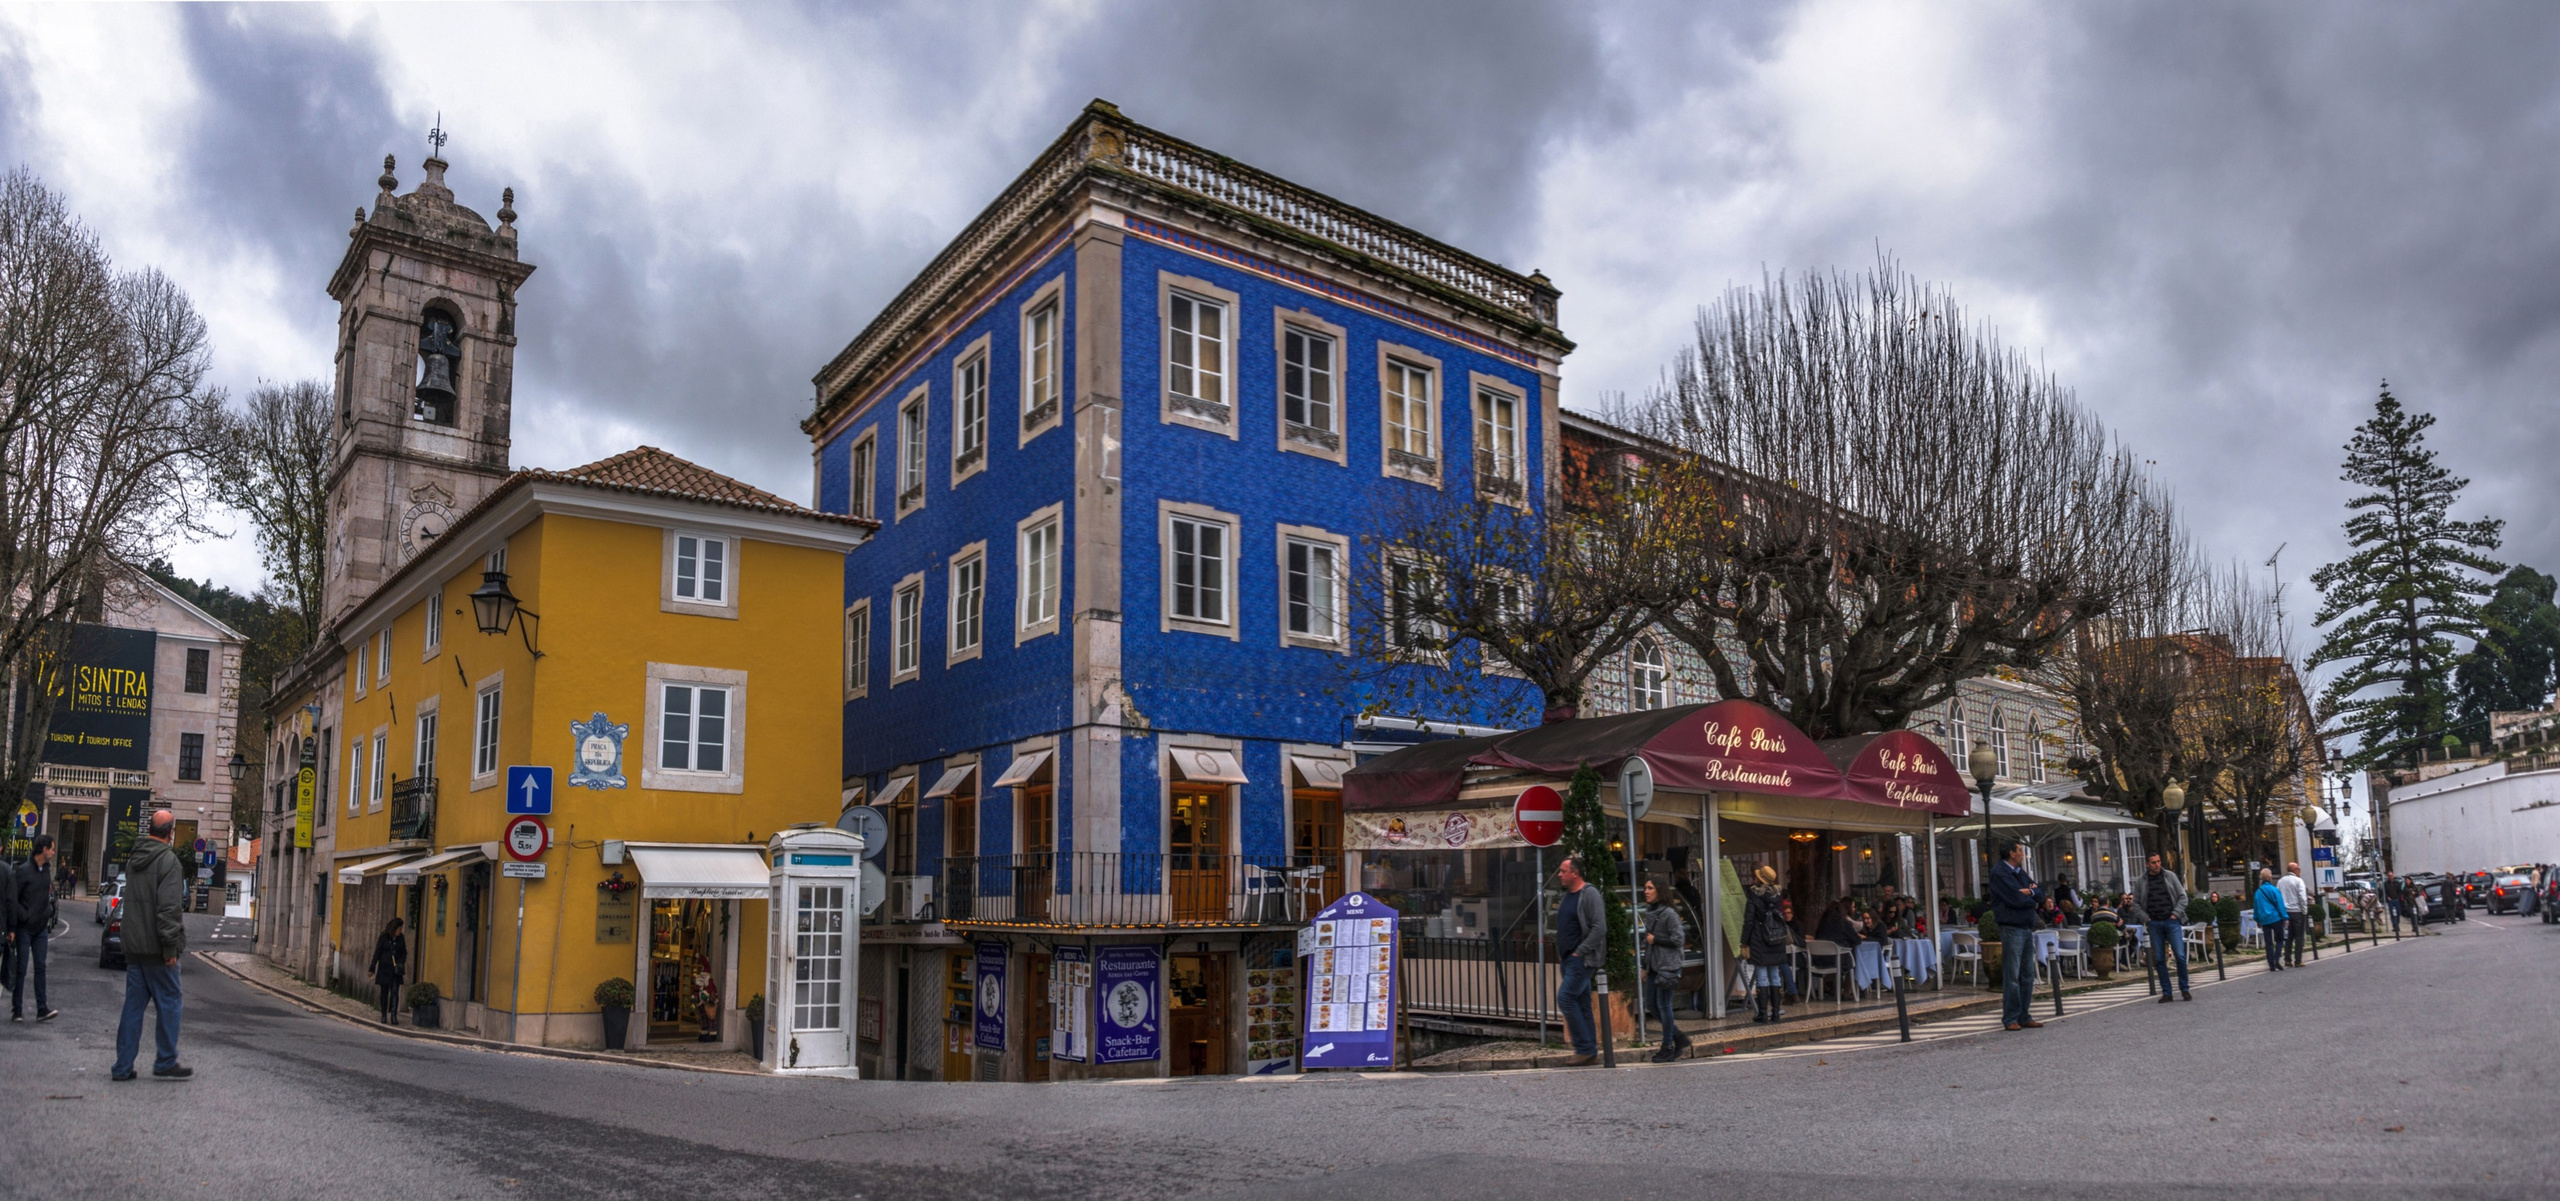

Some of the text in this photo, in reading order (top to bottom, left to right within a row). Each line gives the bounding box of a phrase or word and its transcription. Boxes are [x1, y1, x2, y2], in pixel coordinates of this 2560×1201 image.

[79, 666, 147, 697] SINTRA
[78, 693, 147, 710] MITOS E LENDAS
[50, 732, 75, 744] TURISMO
[86, 735, 111, 746] TOURISM
[112, 738, 133, 748] OFFICE
[1703, 721, 1787, 756] Café Paris
[590, 743, 607, 751] PRAÇA
[1879, 749, 1938, 778] Café Paris
[1705, 759, 1793, 788] Restaurante
[52, 786, 102, 798] TURISMO
[1884, 780, 1940, 807] Cafetaria
[7, 838, 34, 851] SNTRA
[517, 840, 533, 851] 5,5t
[978, 953, 1005, 966] Restaurante
[1100, 960, 1156, 971] Restaurante
[979, 1022, 1001, 1035] Snack-Bar
[980, 1032, 1000, 1045] Cafetaria
[1105, 1034, 1152, 1047] Snack-Bar
[1107, 1045, 1148, 1058] Cafetaria
